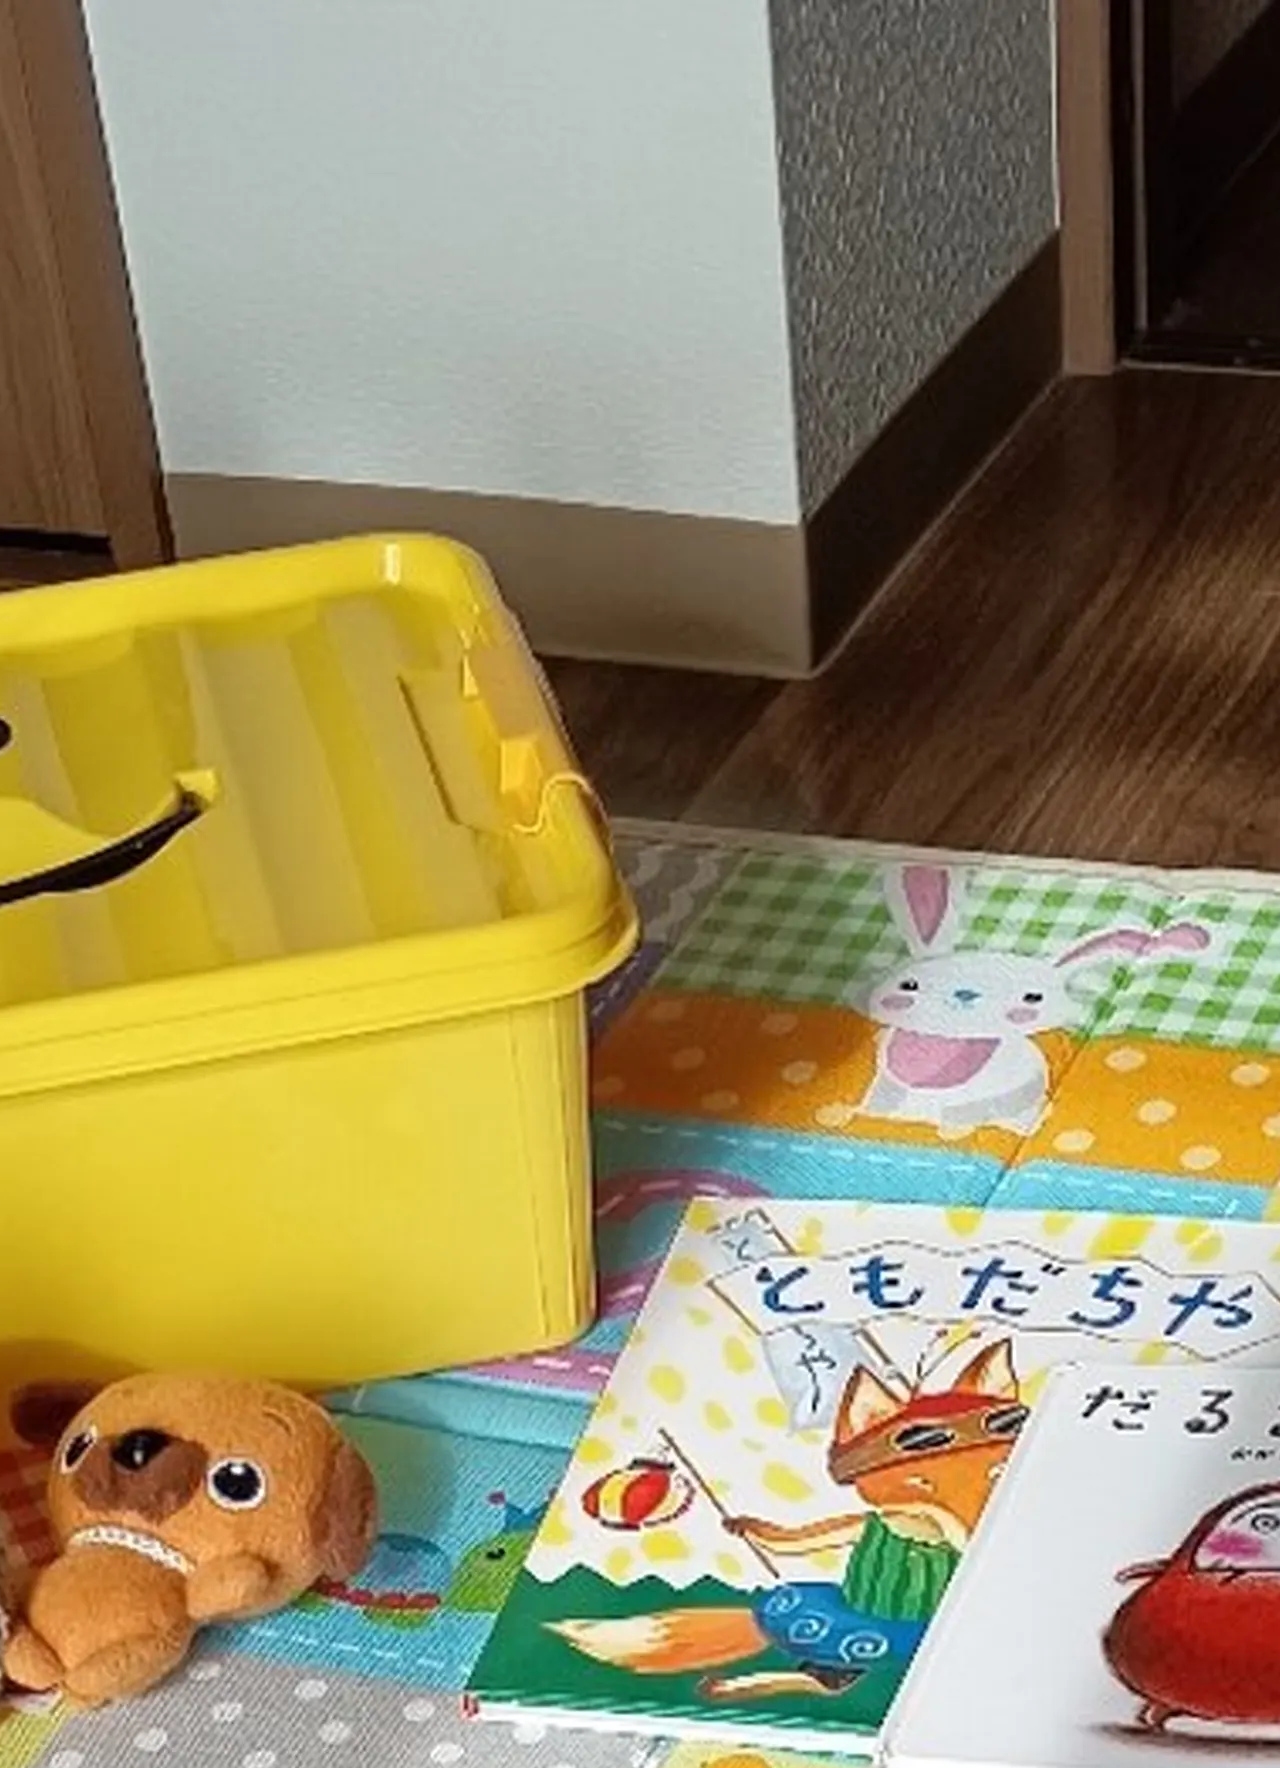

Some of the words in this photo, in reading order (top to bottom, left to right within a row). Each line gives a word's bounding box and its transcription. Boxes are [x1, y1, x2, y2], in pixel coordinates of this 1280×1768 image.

[754, 1254, 1255, 1334] ともだちや
